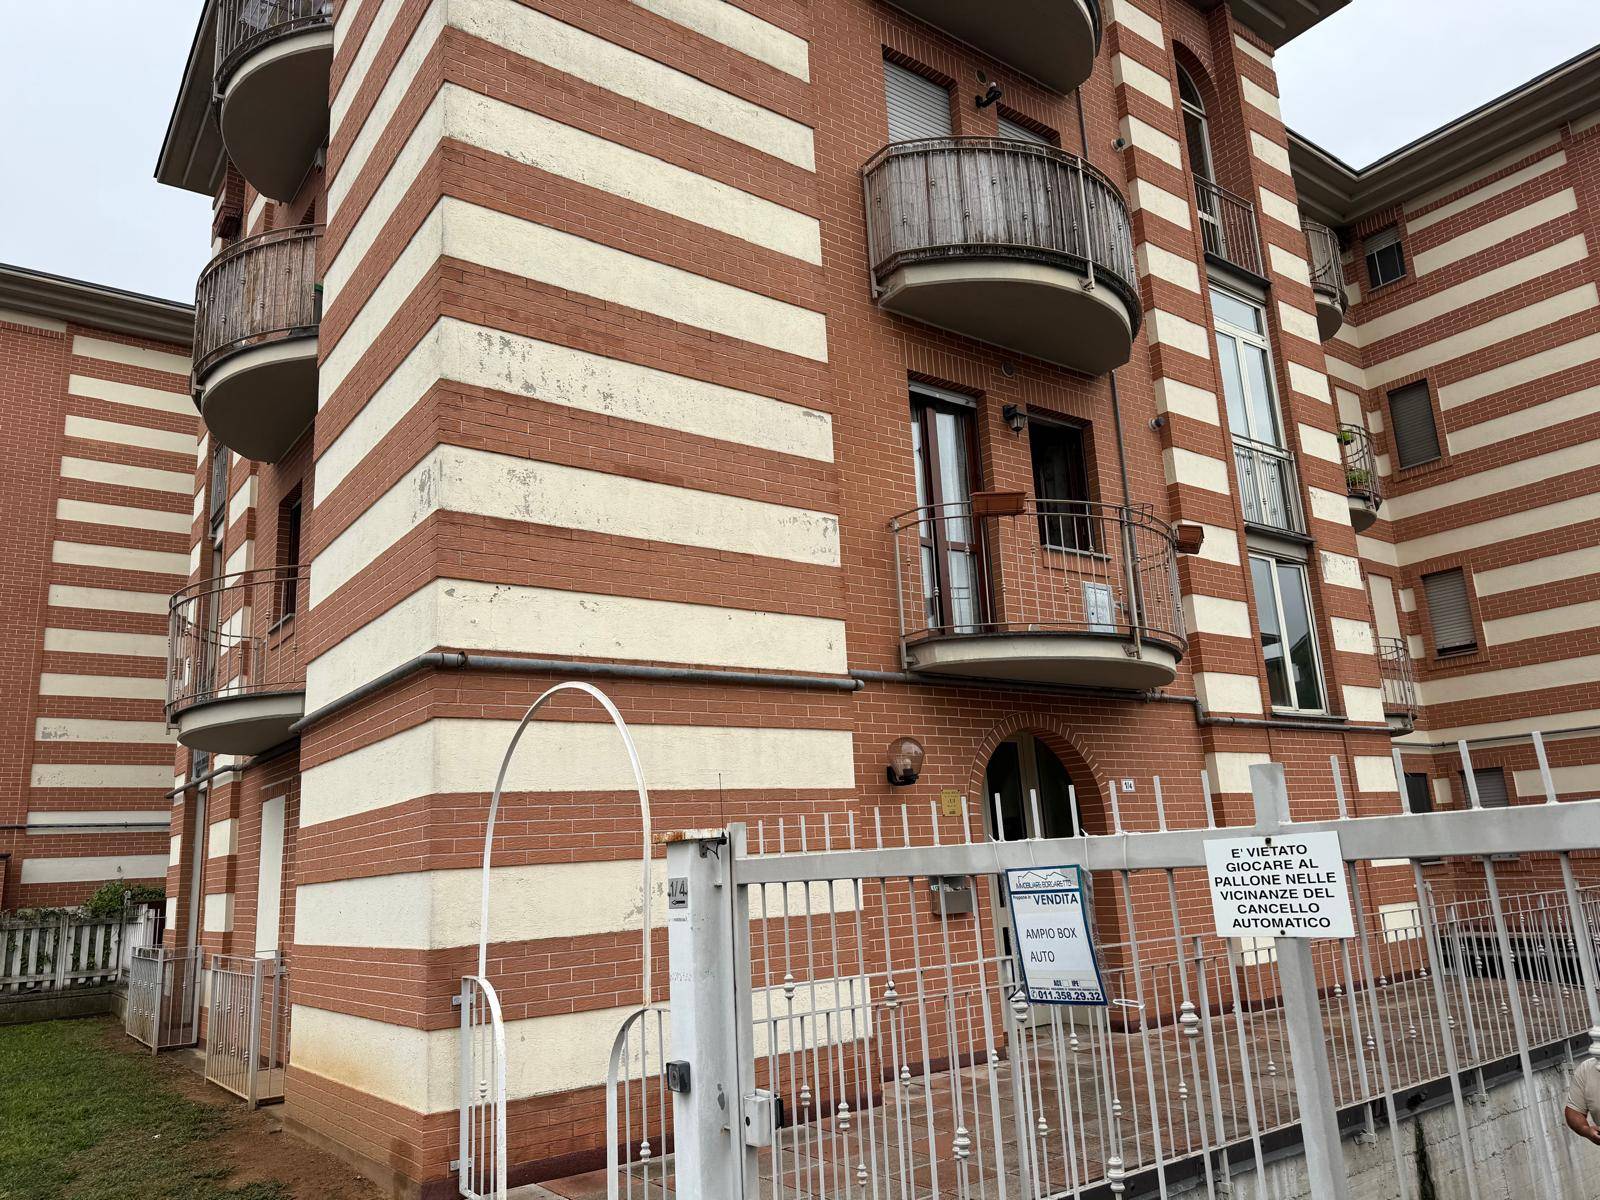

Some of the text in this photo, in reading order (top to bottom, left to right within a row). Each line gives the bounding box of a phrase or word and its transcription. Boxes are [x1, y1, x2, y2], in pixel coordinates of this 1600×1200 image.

[1231, 844, 1307, 858] E' VIETATO
[1225, 858, 1319, 872] GIOCARE AL
[1214, 872, 1336, 887] PALLONE NELLE
[670, 880, 685, 897] 1/4
[1220, 887, 1335, 901] VICINANZE DEL
[1033, 893, 1079, 905] VENDITA
[1237, 902, 1320, 914] CANCELLO
[1232, 917, 1331, 928] AUTOMATICO
[1026, 927, 1077, 939] AMPIO BOX
[1030, 950, 1055, 962] AUTO
[1038, 990, 1102, 1001] 011.358.29.32
